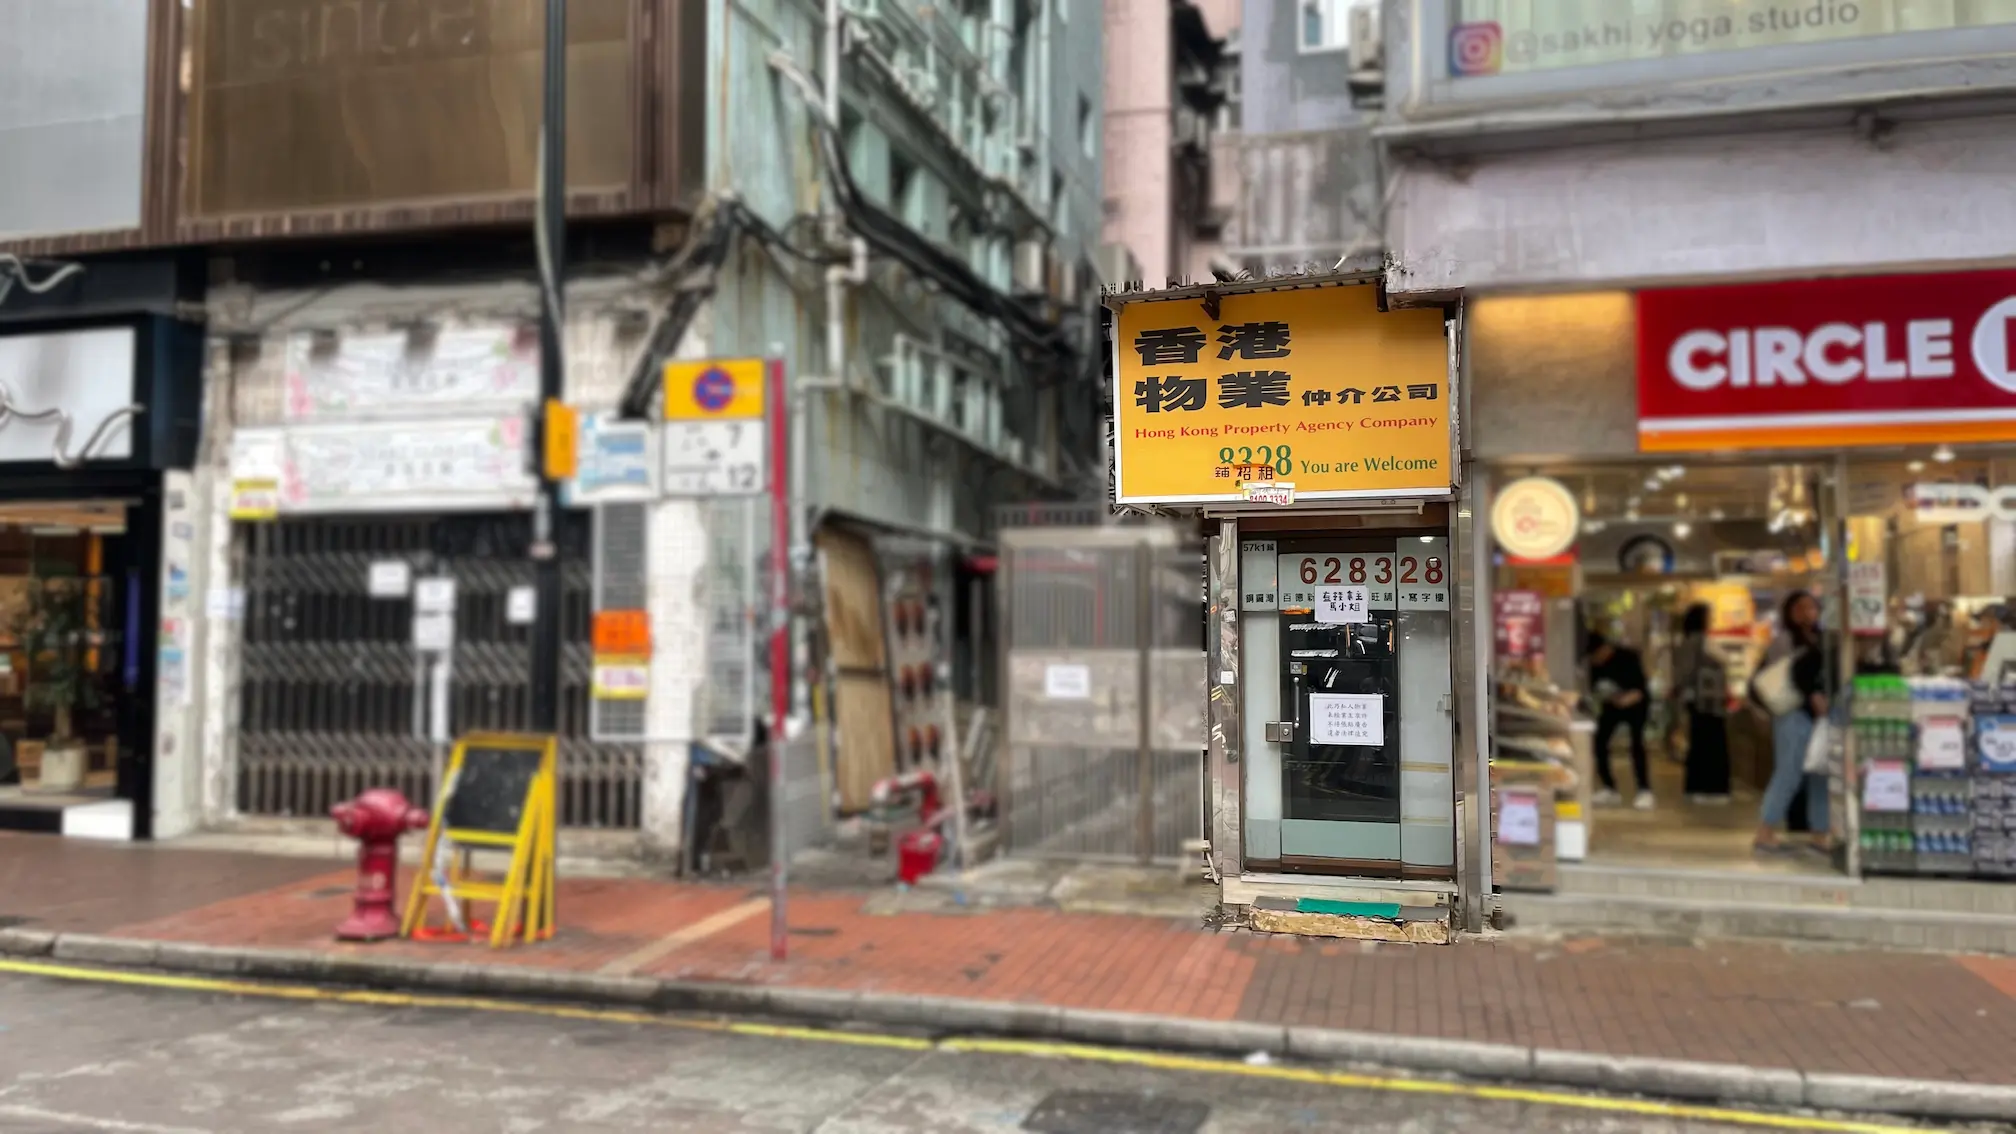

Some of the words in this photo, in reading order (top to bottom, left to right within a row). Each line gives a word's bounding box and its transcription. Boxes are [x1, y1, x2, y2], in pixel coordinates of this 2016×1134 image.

[1134, 321, 1291, 366] 香港
[1668, 318, 1955, 390] CIRCLE
[1134, 370, 1291, 413] 物業
[1301, 383, 1438, 406] 仲介公司
[1135, 427, 1175, 439] Hong
[1180, 425, 1218, 437] Kong
[1224, 421, 1290, 436] Property
[1296, 418, 1354, 432] Agency
[1360, 416, 1438, 429] Company
[1300, 460, 1329, 474] You
[1335, 461, 1359, 473] are
[1363, 455, 1438, 472] Welcome
